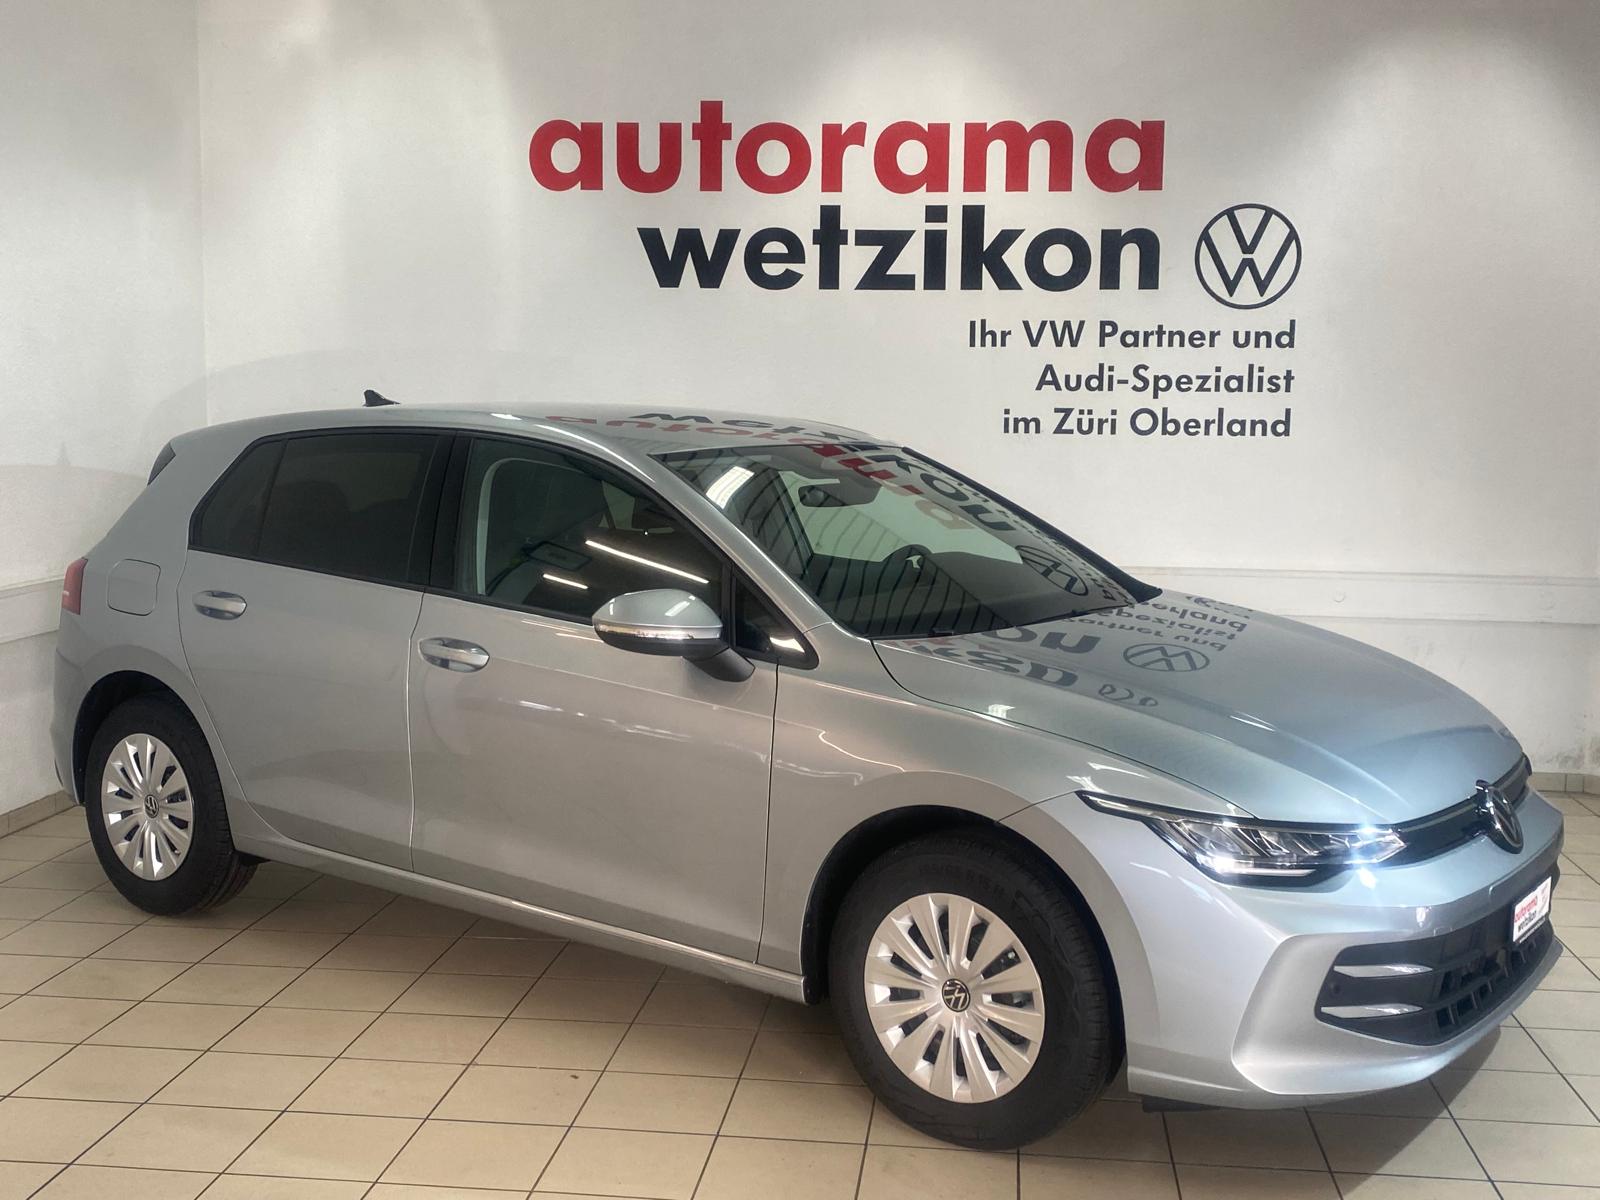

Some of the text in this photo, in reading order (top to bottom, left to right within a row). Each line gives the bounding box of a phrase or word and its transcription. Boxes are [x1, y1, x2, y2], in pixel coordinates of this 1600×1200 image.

[530, 101, 1165, 194] autorama
[637, 205, 1160, 292] wetzikon
[969, 319, 1295, 349] Ihr VW Partner und
[1036, 363, 1295, 400] Audi-Spezialist
[1003, 407, 1292, 437] im Züri Oberland
